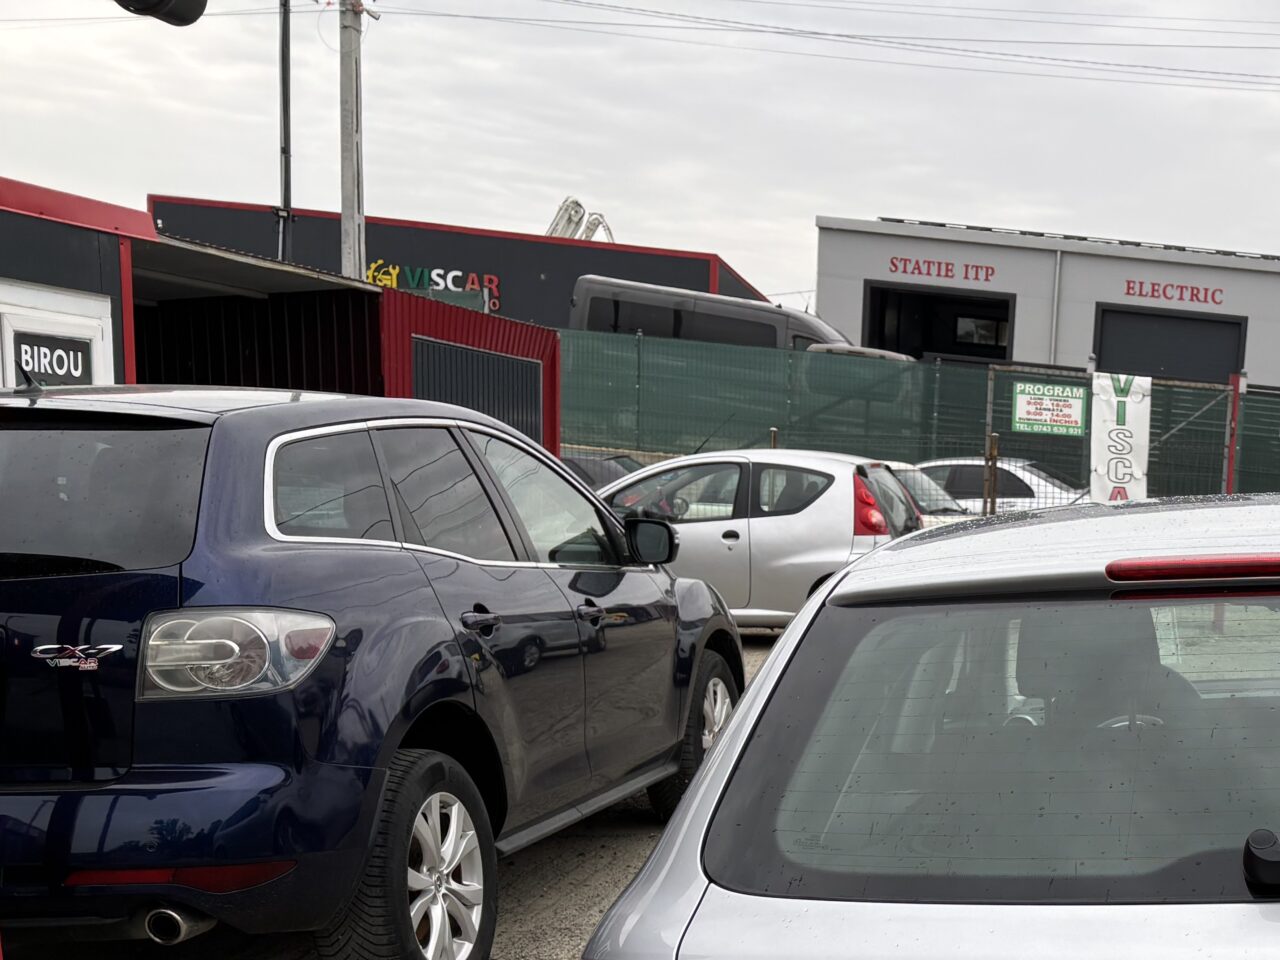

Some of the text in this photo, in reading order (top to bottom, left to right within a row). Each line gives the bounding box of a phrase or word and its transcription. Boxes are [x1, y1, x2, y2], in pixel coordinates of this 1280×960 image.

[404, 266, 500, 297] VISCAR
[888, 256, 996, 282] STATIE ITP
[1124, 279, 1225, 305] ELECTRIC
[20, 343, 82, 378] BIROU
[1016, 383, 1084, 398] PROGRAM
[1016, 423, 1031, 431] TEL:
[1033, 424, 1051, 432] 0743
[30, 644, 124, 658] CX-7
